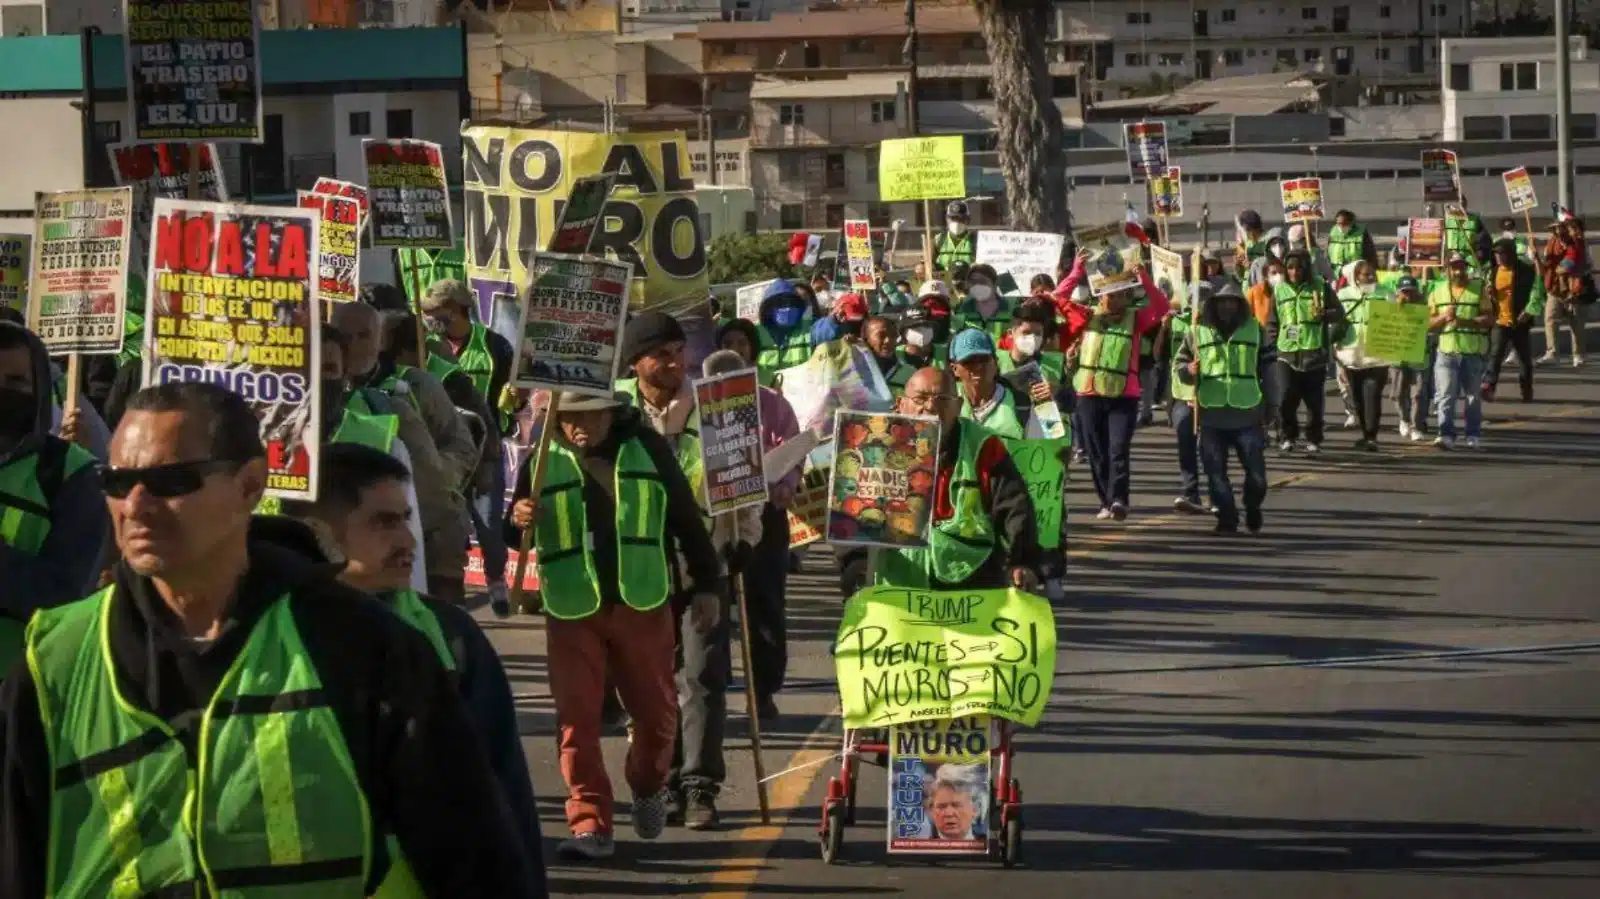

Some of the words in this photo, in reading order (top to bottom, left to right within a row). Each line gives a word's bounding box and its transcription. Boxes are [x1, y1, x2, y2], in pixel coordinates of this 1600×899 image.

[178, 41, 245, 61] PATIO
[141, 65, 248, 85] TRASERO
[464, 136, 562, 192] NO
[602, 142, 694, 193] AL
[376, 201, 444, 213] TRASERO
[155, 210, 214, 273] NO
[217, 220, 244, 275] A
[254, 223, 308, 278] LA
[41, 254, 121, 270] TERRITORIO
[159, 272, 304, 302] INTERVENCION
[182, 295, 201, 314] DE
[204, 296, 226, 317] LOS
[158, 316, 176, 336] EN
[180, 318, 233, 342] ASUNTOS
[237, 323, 263, 343] QUE
[267, 327, 304, 346] SOLO
[248, 345, 304, 367] MEXICO
[160, 363, 305, 403] GRINGOS
[873, 588, 984, 623] TRUMP
[840, 625, 967, 671] PUENTES
[991, 617, 1038, 668] SI
[863, 664, 970, 714] MUROS
[991, 663, 1041, 710] NO
[896, 731, 987, 755] MURO
[895, 757, 925, 838] TRUMP
